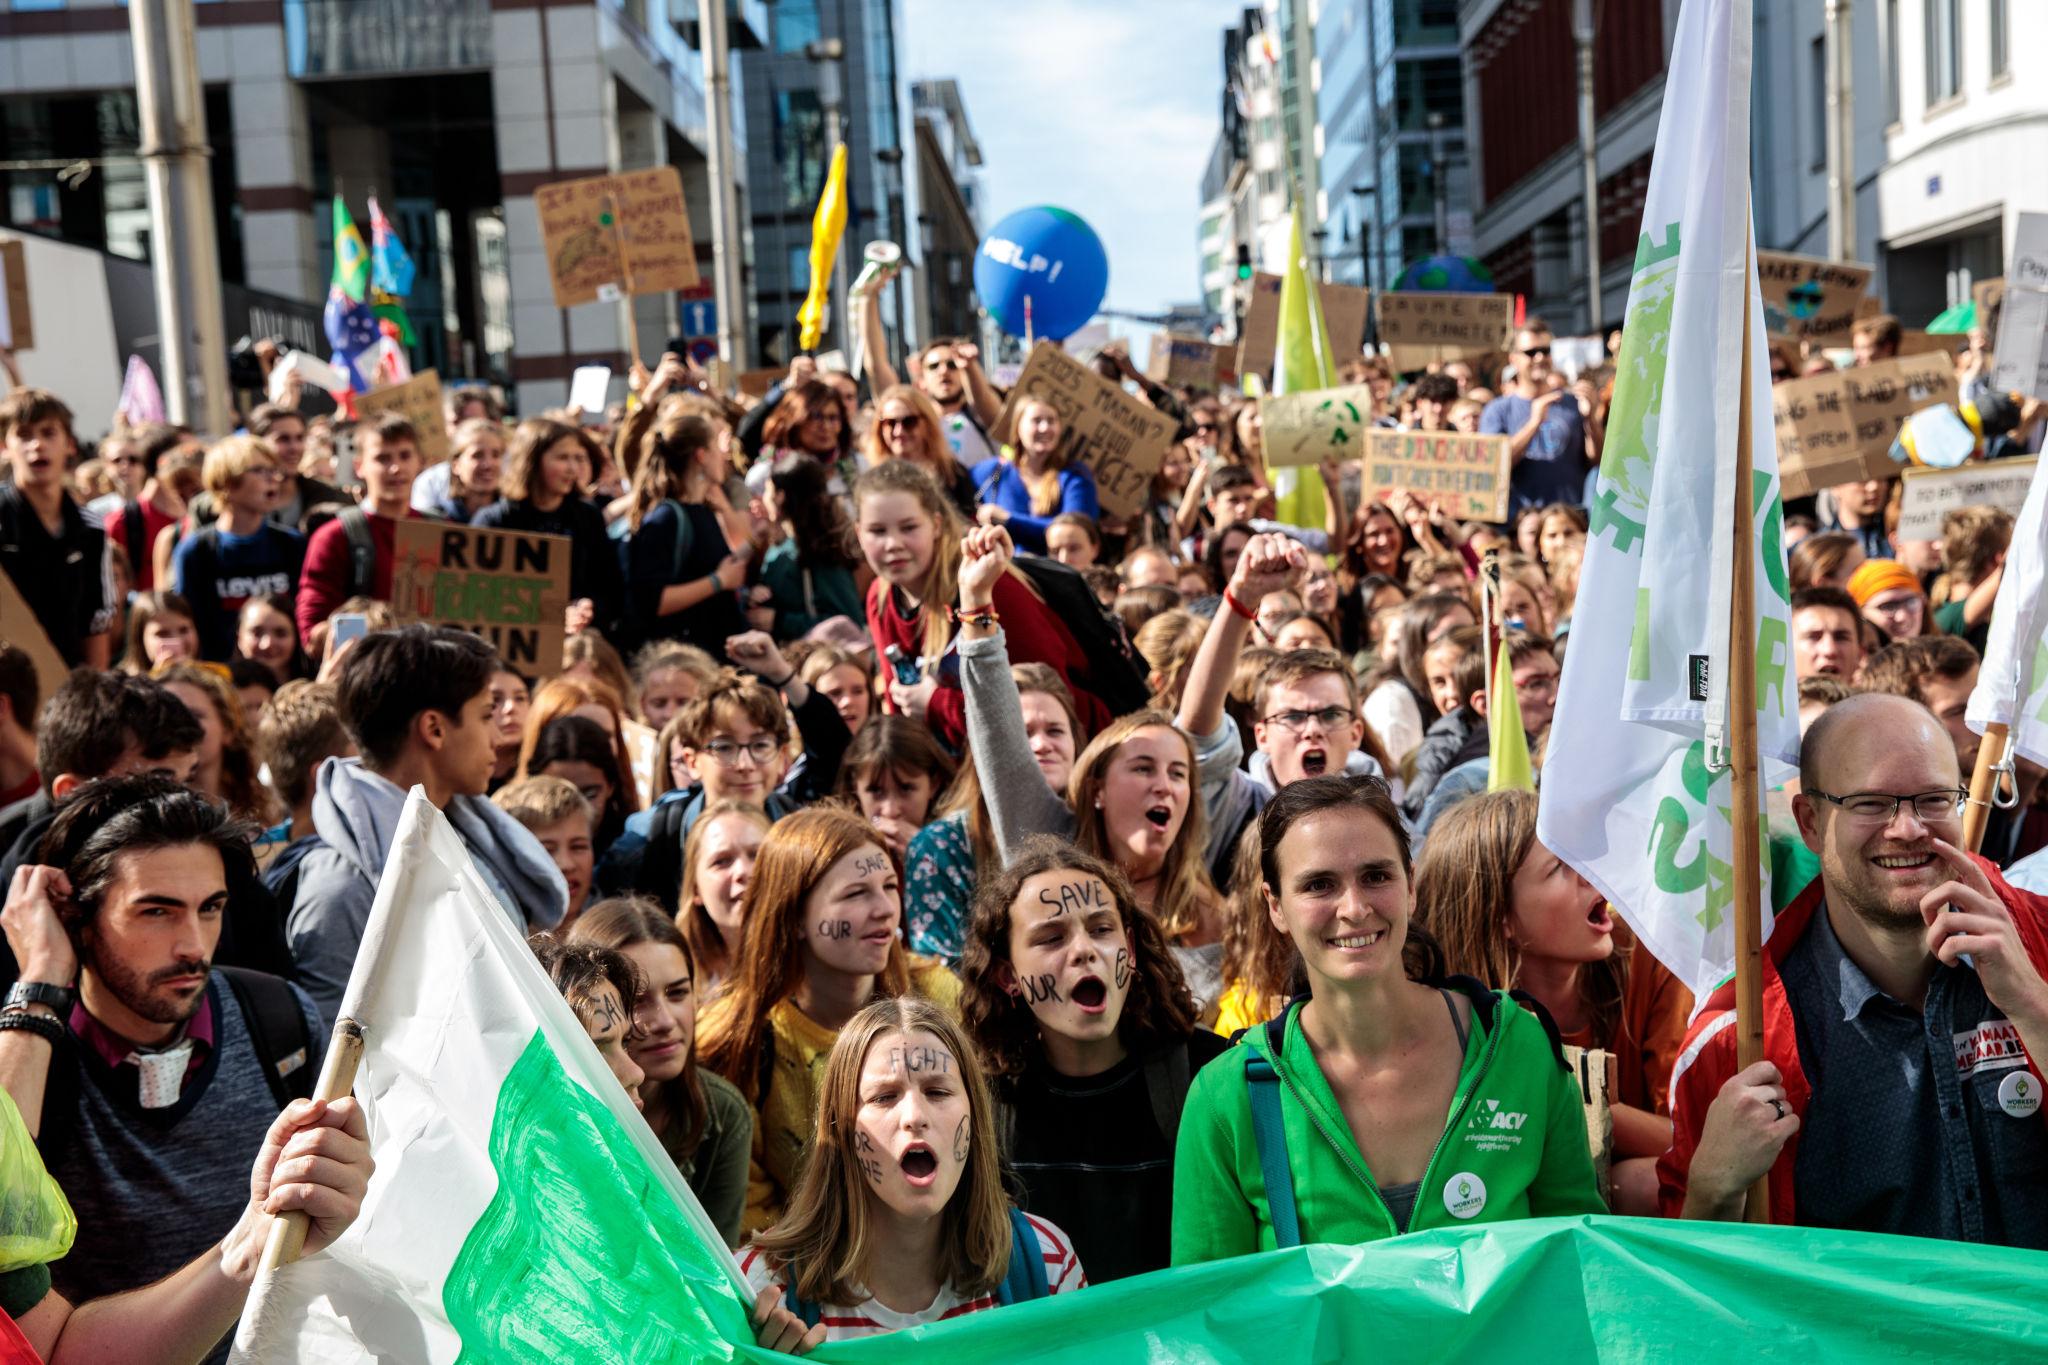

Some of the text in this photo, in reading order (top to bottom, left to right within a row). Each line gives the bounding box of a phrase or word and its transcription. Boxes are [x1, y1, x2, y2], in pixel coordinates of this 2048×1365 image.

[983, 235, 1064, 284] HELP!
[1372, 435, 1401, 460] THE
[441, 529, 550, 575] RUN
[433, 571, 554, 625] FOREST
[854, 852, 889, 878] SAVE
[1039, 880, 1110, 920] SAVE
[818, 919, 852, 941] OUR
[1020, 972, 1064, 1006] OUR
[889, 1045, 951, 1081] FIGHT
[1489, 1111, 1529, 1130] ACV
[854, 1130, 875, 1153] OR
[860, 1157, 884, 1185] HE
